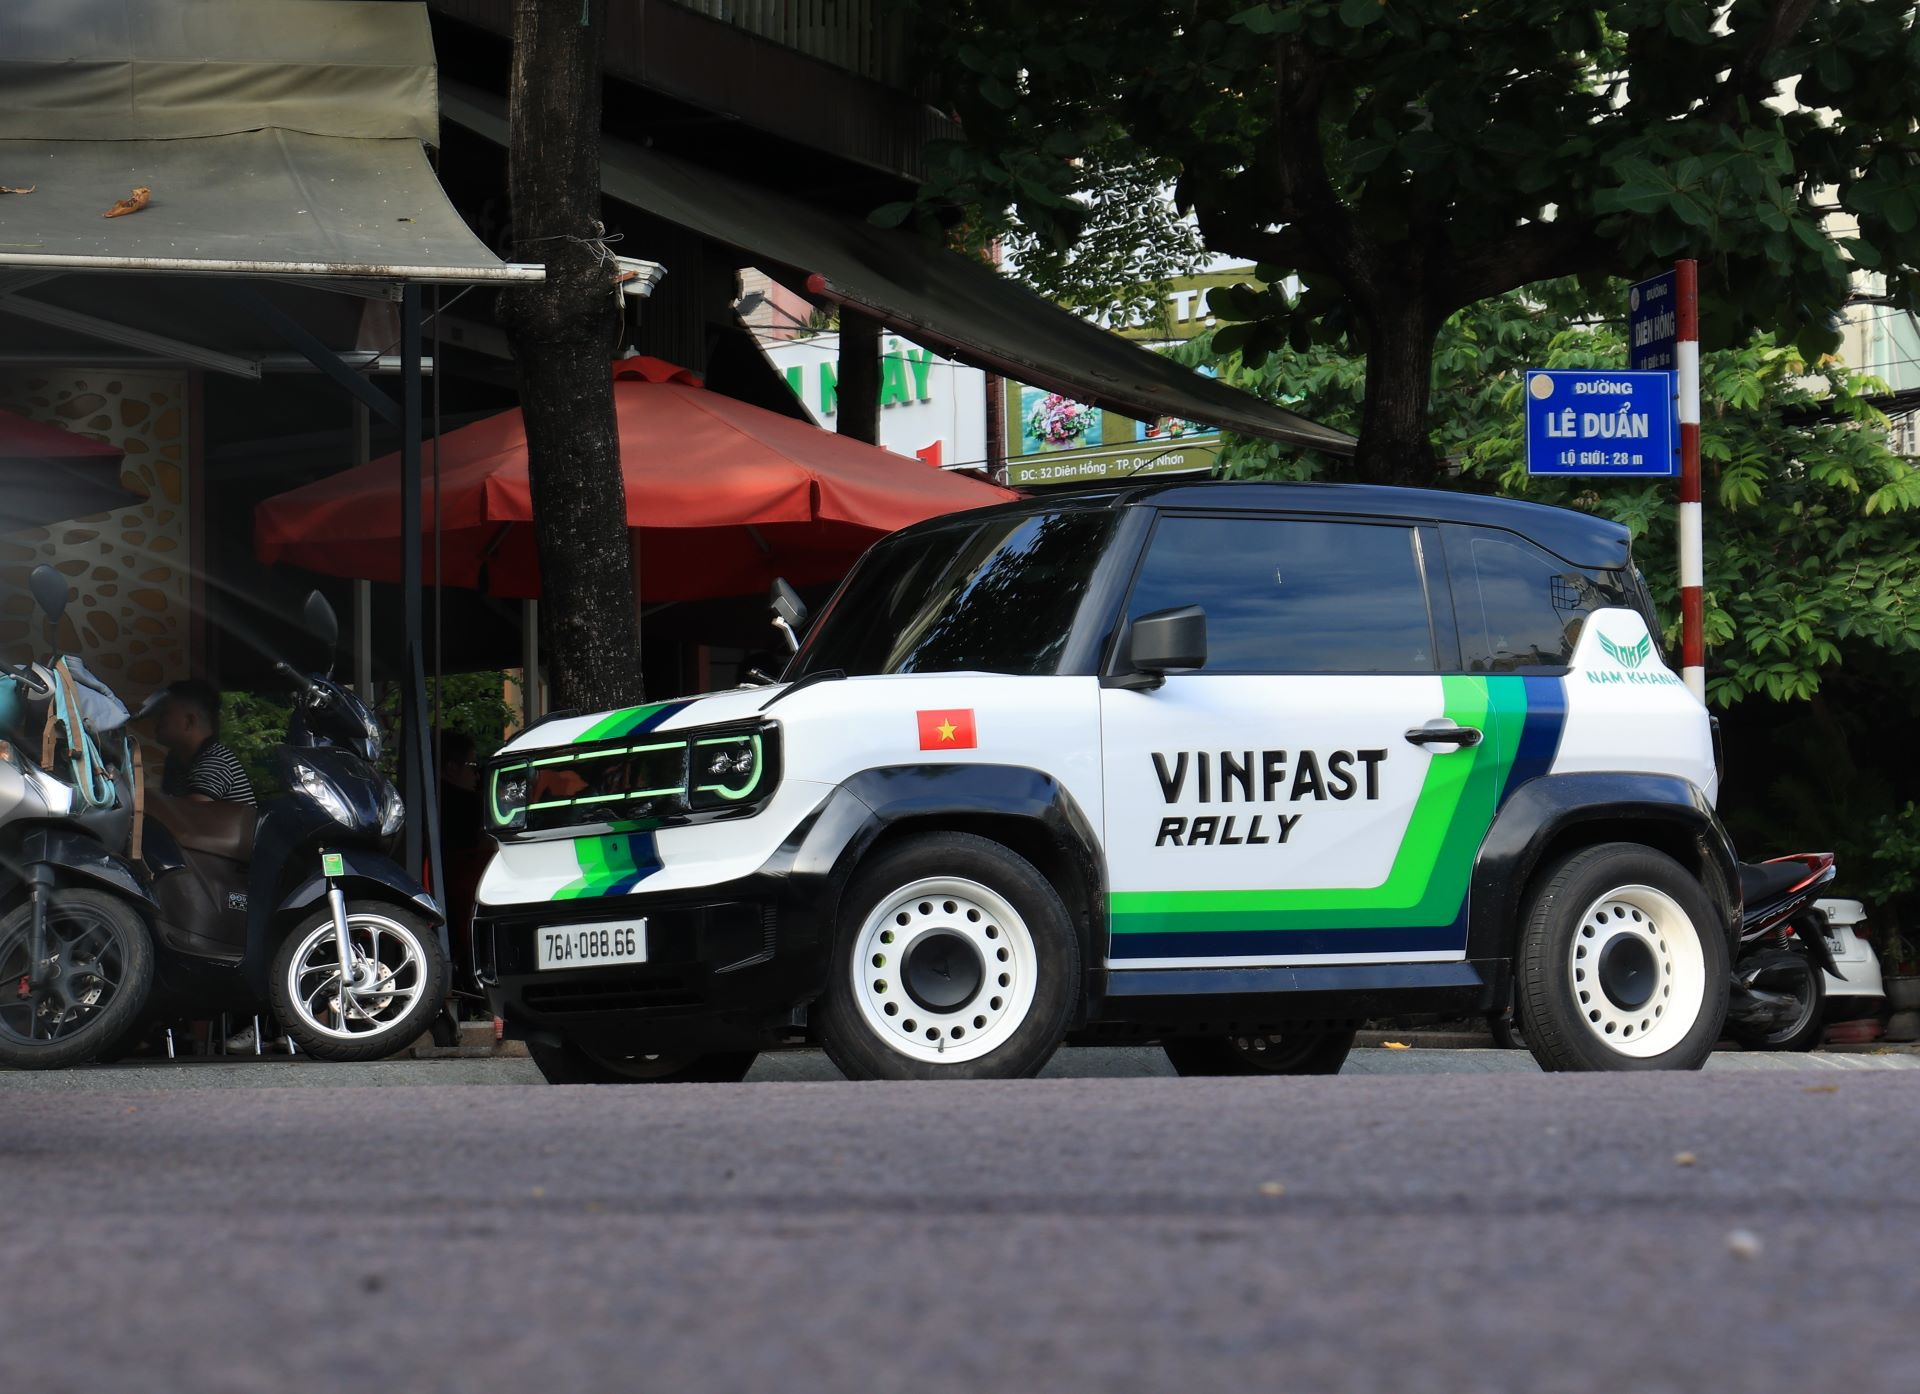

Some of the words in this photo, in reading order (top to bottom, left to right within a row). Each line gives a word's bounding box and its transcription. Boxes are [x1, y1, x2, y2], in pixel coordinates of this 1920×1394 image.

[1575, 379, 1633, 394] ĐƯỜNG
[1548, 407, 1577, 438] LÊ
[1584, 401, 1649, 438] DUẨN
[1021, 469, 1038, 480] ĐC:
[1040, 467, 1052, 479] 32
[1054, 465, 1077, 478] Diên
[1079, 460, 1106, 475] Hồng
[1116, 459, 1131, 470] TP.
[1156, 454, 1184, 466] Nhơn
[1561, 449, 1576, 466] LỘ
[1580, 450, 1609, 465] GIỚI:
[1613, 452, 1629, 465] 28
[1633, 454, 1643, 465] m
[1586, 671, 1626, 684] NAM
[1151, 748, 1388, 803] VINFAST
[1155, 813, 1304, 847] RALLY
